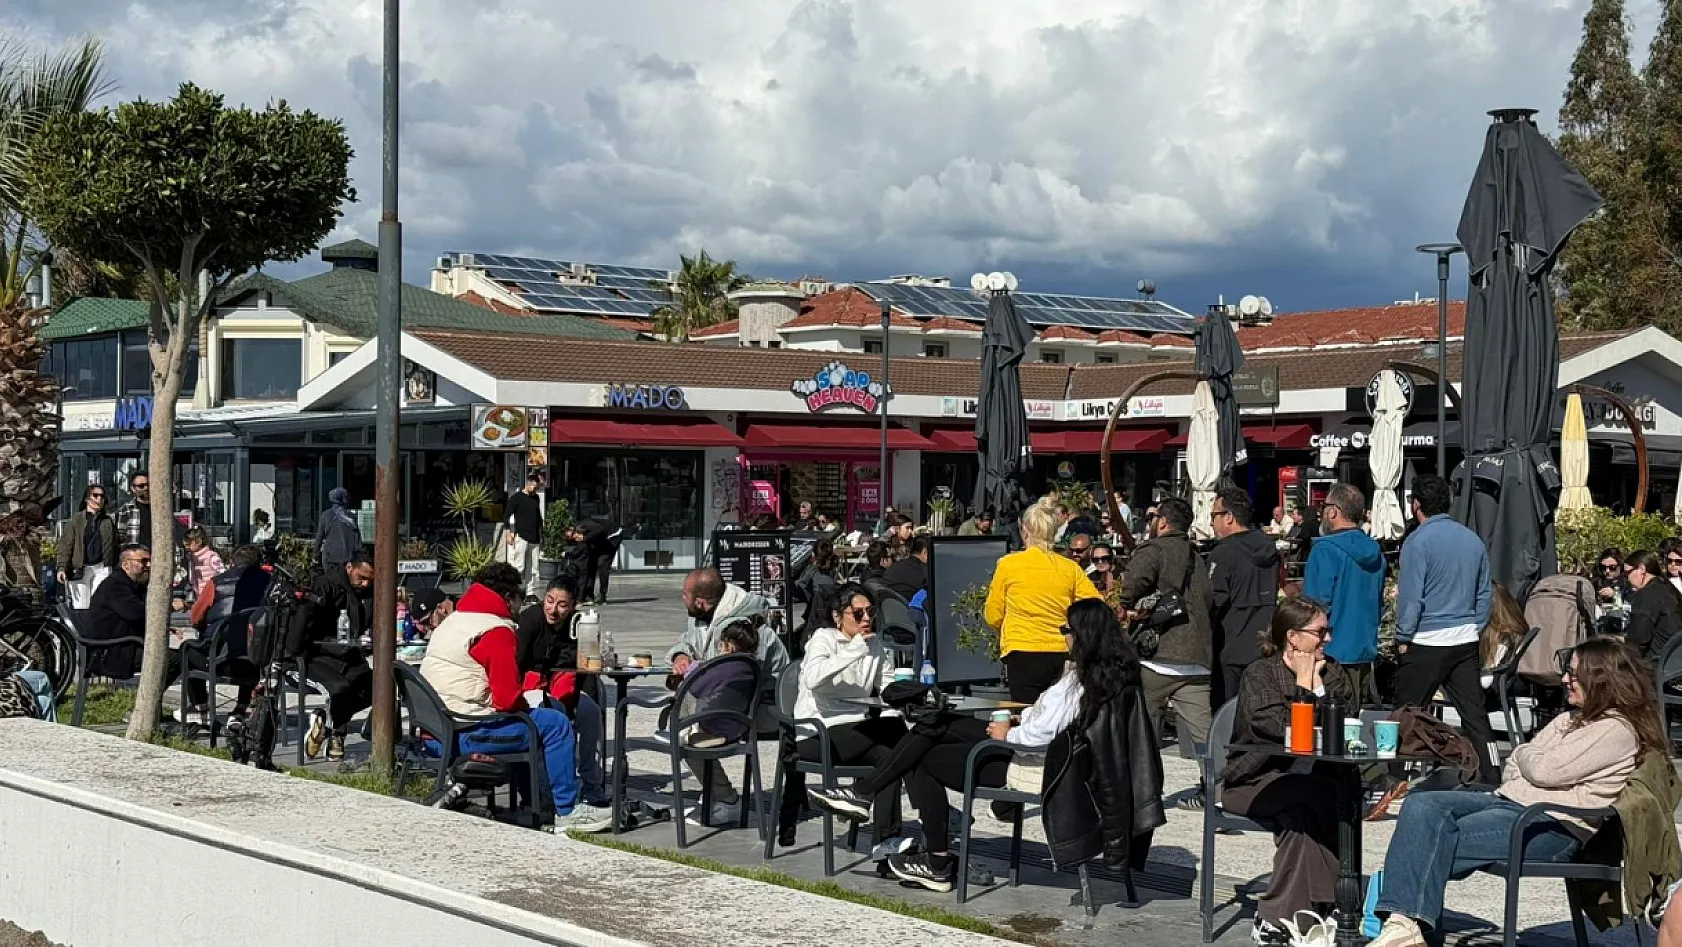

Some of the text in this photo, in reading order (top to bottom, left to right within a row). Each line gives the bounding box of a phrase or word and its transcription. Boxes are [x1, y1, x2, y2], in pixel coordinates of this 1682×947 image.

[609, 385, 684, 410] MADO
[808, 387, 877, 412] HEAVEN
[1083, 402, 1105, 417] Likya
[1310, 435, 1349, 448] Coffee
